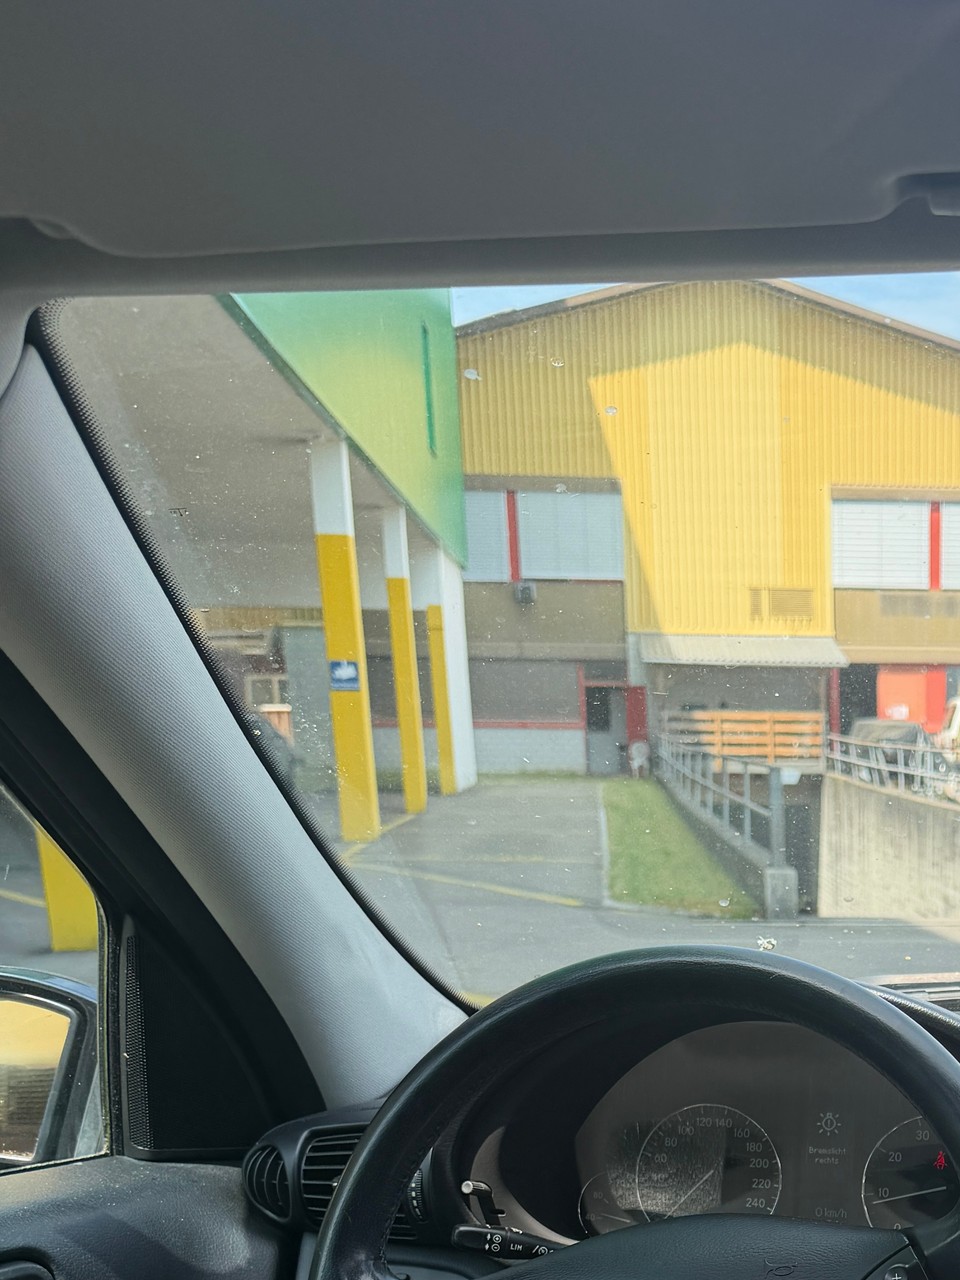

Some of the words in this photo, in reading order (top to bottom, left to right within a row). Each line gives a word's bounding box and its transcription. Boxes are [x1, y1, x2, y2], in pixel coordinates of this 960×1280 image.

[696, 1117, 712, 1128] 120
[715, 1118, 732, 1128] 140
[678, 1125, 694, 1136] 100
[734, 1128, 750, 1138] 160
[914, 1130, 930, 1141] 30
[664, 1137, 678, 1148] 80
[746, 1142, 762, 1152] 180
[808, 1146, 848, 1155] Bremslicht
[814, 1156, 840, 1165] rechts
[888, 1151, 902, 1162] 20
[749, 1158, 770, 1169] 200
[752, 1178, 772, 1189] 220
[878, 1187, 890, 1198] 10
[746, 1198, 766, 1209] 240
[815, 1208, 822, 1217] 0
[824, 1208, 848, 1218] km/h
[510, 1243, 523, 1252] LIM
